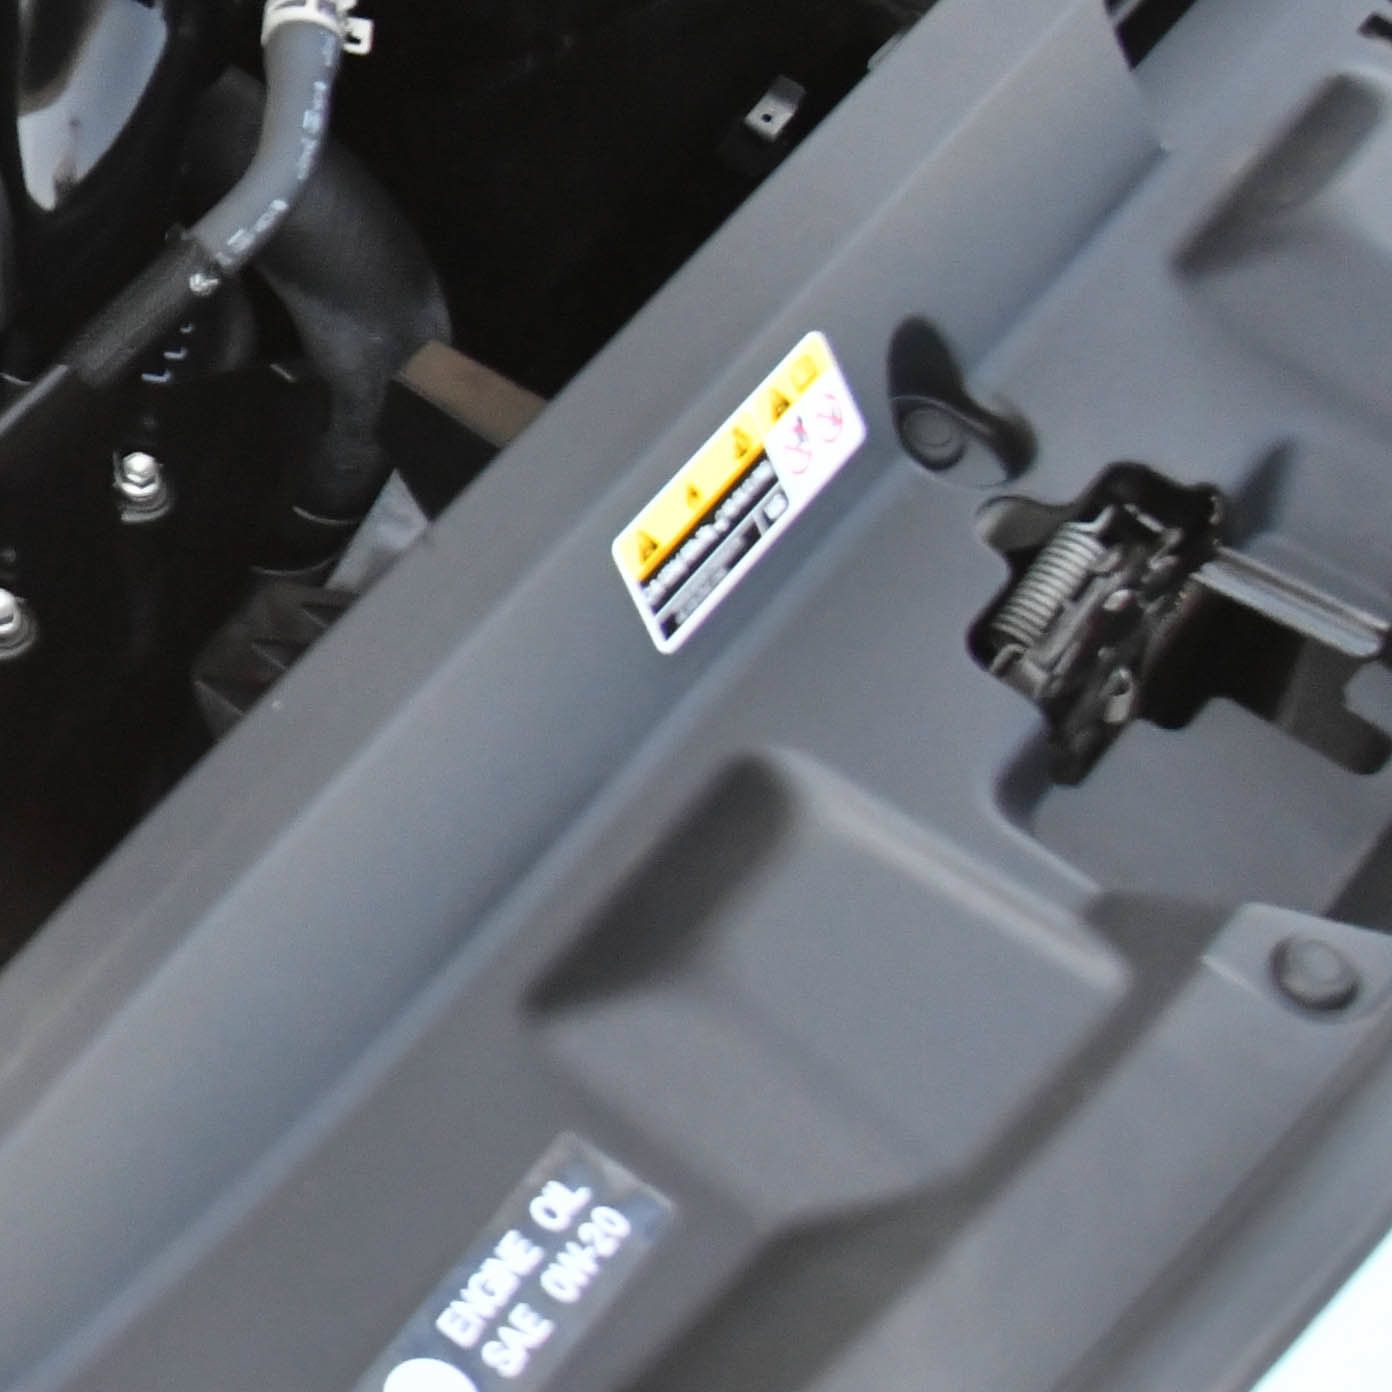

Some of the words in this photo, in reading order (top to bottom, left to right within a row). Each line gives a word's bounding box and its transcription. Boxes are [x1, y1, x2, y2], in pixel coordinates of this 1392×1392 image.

[435, 1228, 546, 1349] ENGINE
[480, 1302, 556, 1379] SAE
[540, 1205, 632, 1304] 0W-20
